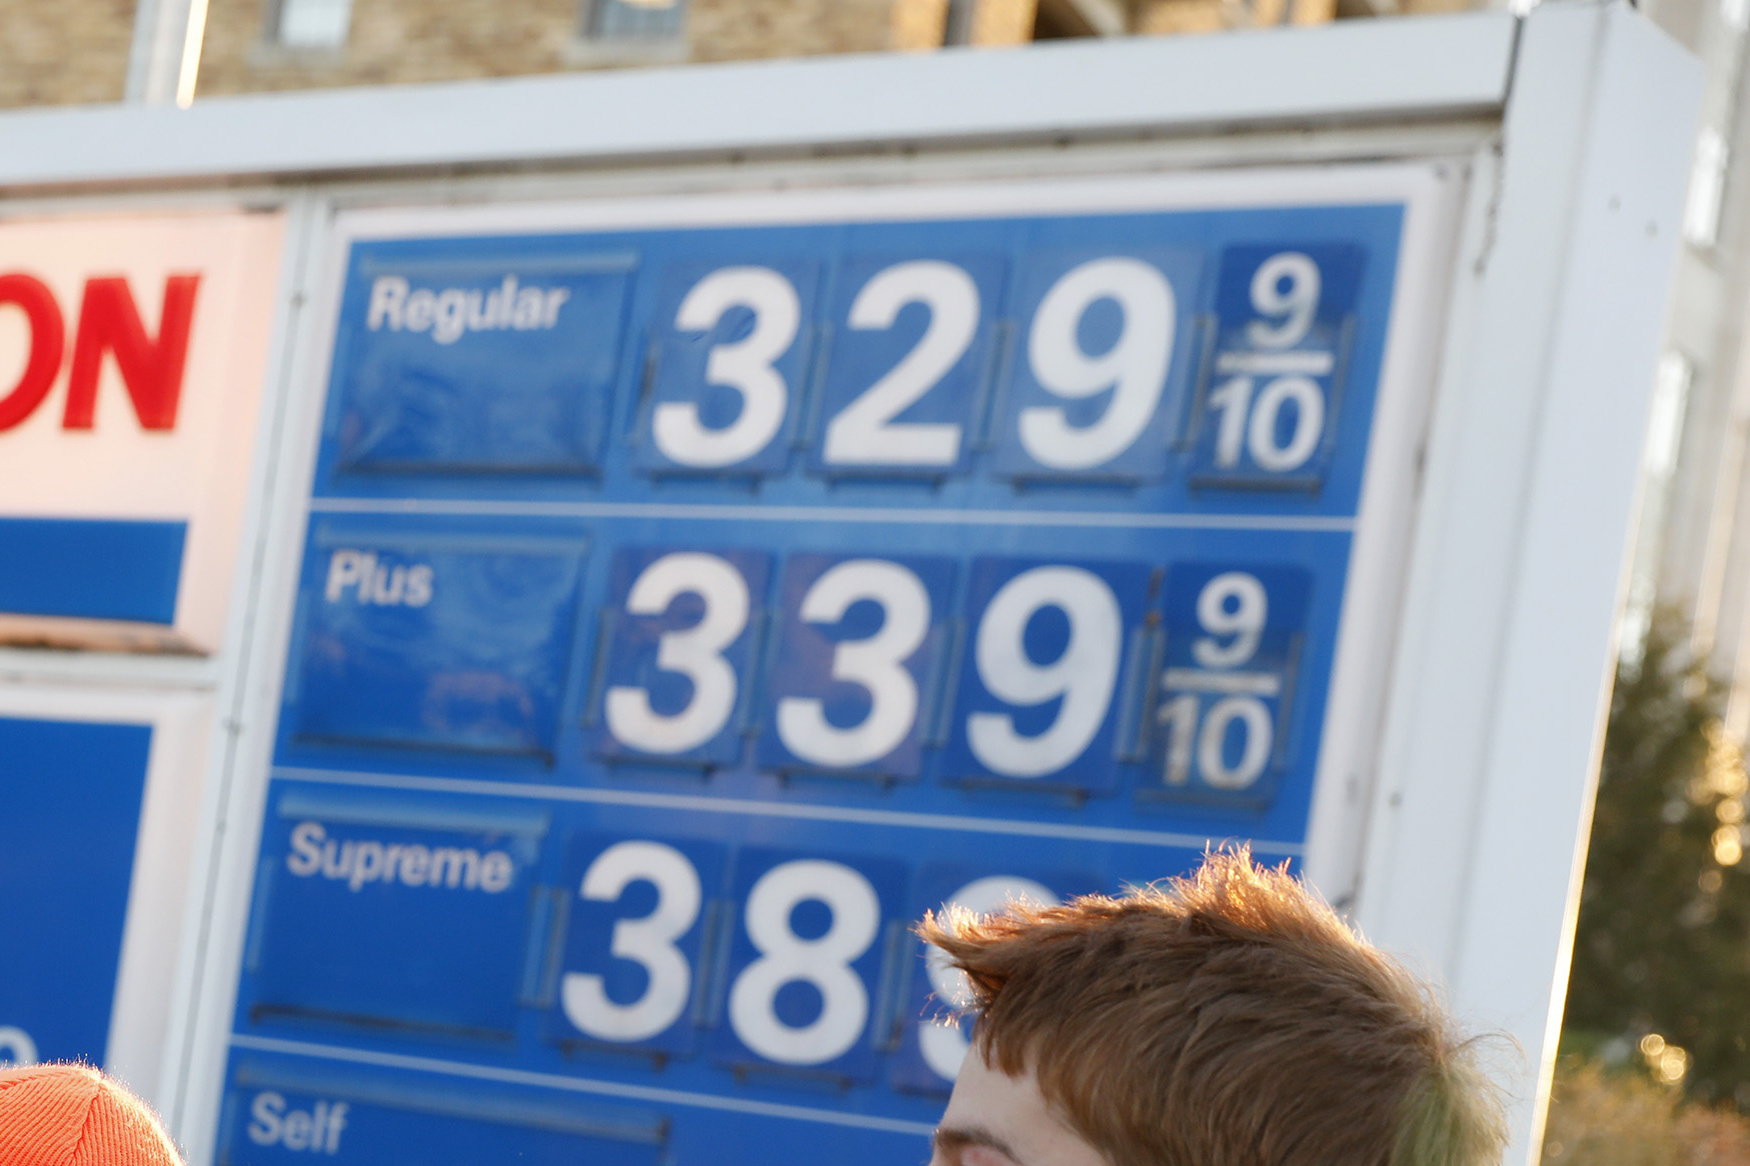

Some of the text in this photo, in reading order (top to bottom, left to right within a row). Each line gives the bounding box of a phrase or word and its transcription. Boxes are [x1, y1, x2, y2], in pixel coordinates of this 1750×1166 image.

[367, 272, 571, 345] Regular
[652, 257, 1178, 472] 329
[324, 550, 433, 608] Plus
[605, 551, 1123, 777] 339
[286, 821, 514, 893] Supreme
[248, 1092, 349, 1156] Self
